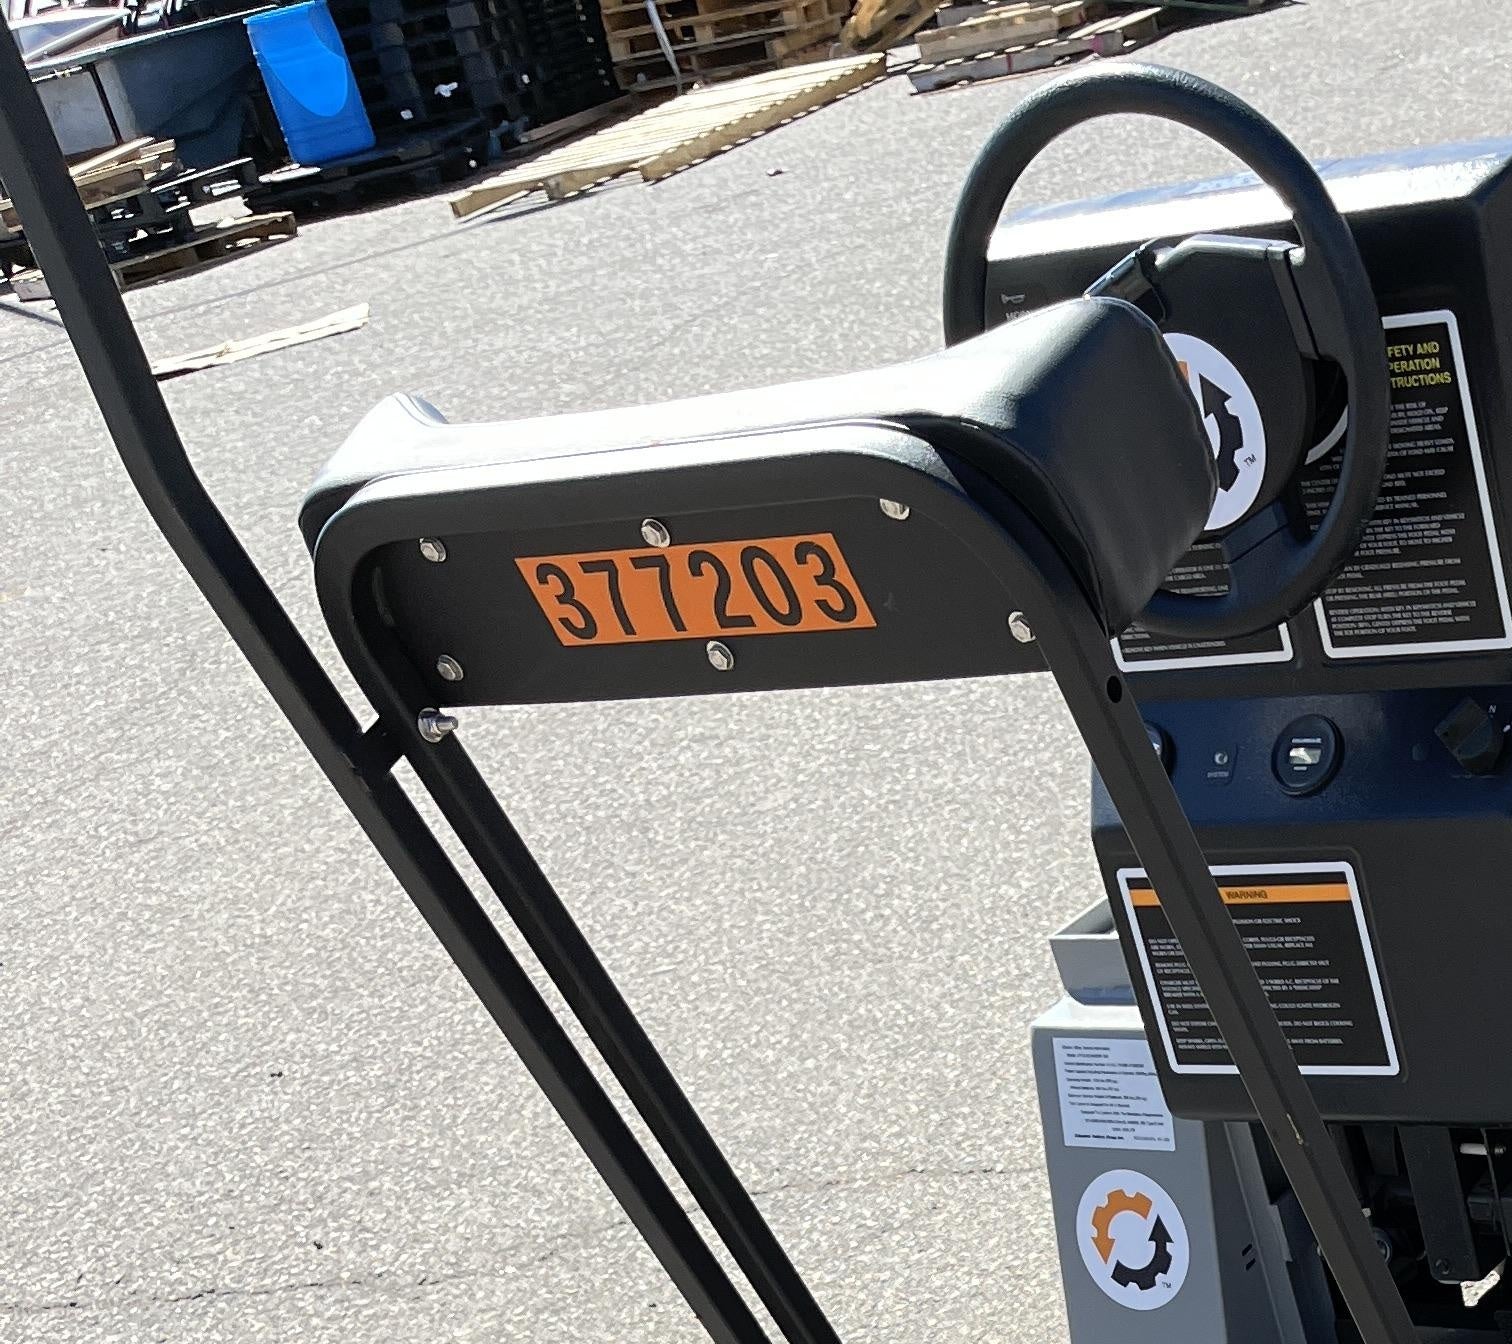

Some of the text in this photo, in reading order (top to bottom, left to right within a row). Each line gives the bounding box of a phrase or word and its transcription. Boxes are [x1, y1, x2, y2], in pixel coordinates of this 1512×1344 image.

[1387, 341, 1440, 358] FETY AND
[1388, 357, 1441, 373] PERATION
[1390, 372, 1452, 388] TRUCTIONS
[536, 541, 858, 640] 377203
[1488, 704, 1497, 714] N
[1225, 889, 1268, 900] WARNING
